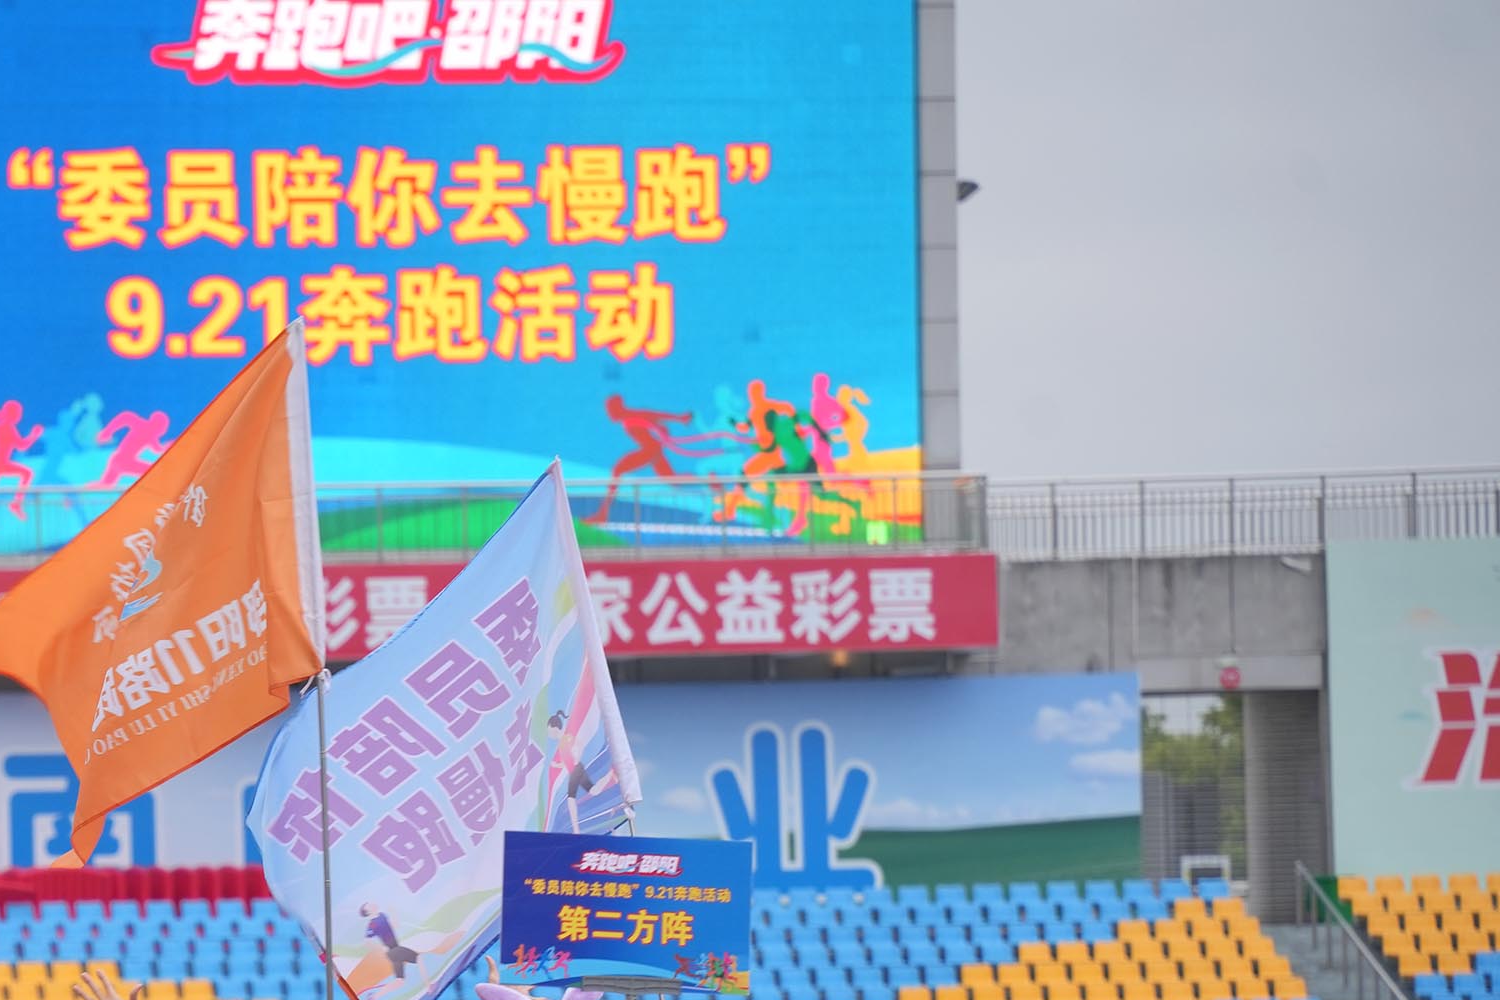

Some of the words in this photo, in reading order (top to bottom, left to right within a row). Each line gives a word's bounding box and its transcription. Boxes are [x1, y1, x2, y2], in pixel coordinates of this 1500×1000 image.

[8, 145, 770, 248] “委员陪你去慢跑”
[106, 264, 675, 363] 9.21奔跑活动
[557, 904, 695, 946] 第二方阵
